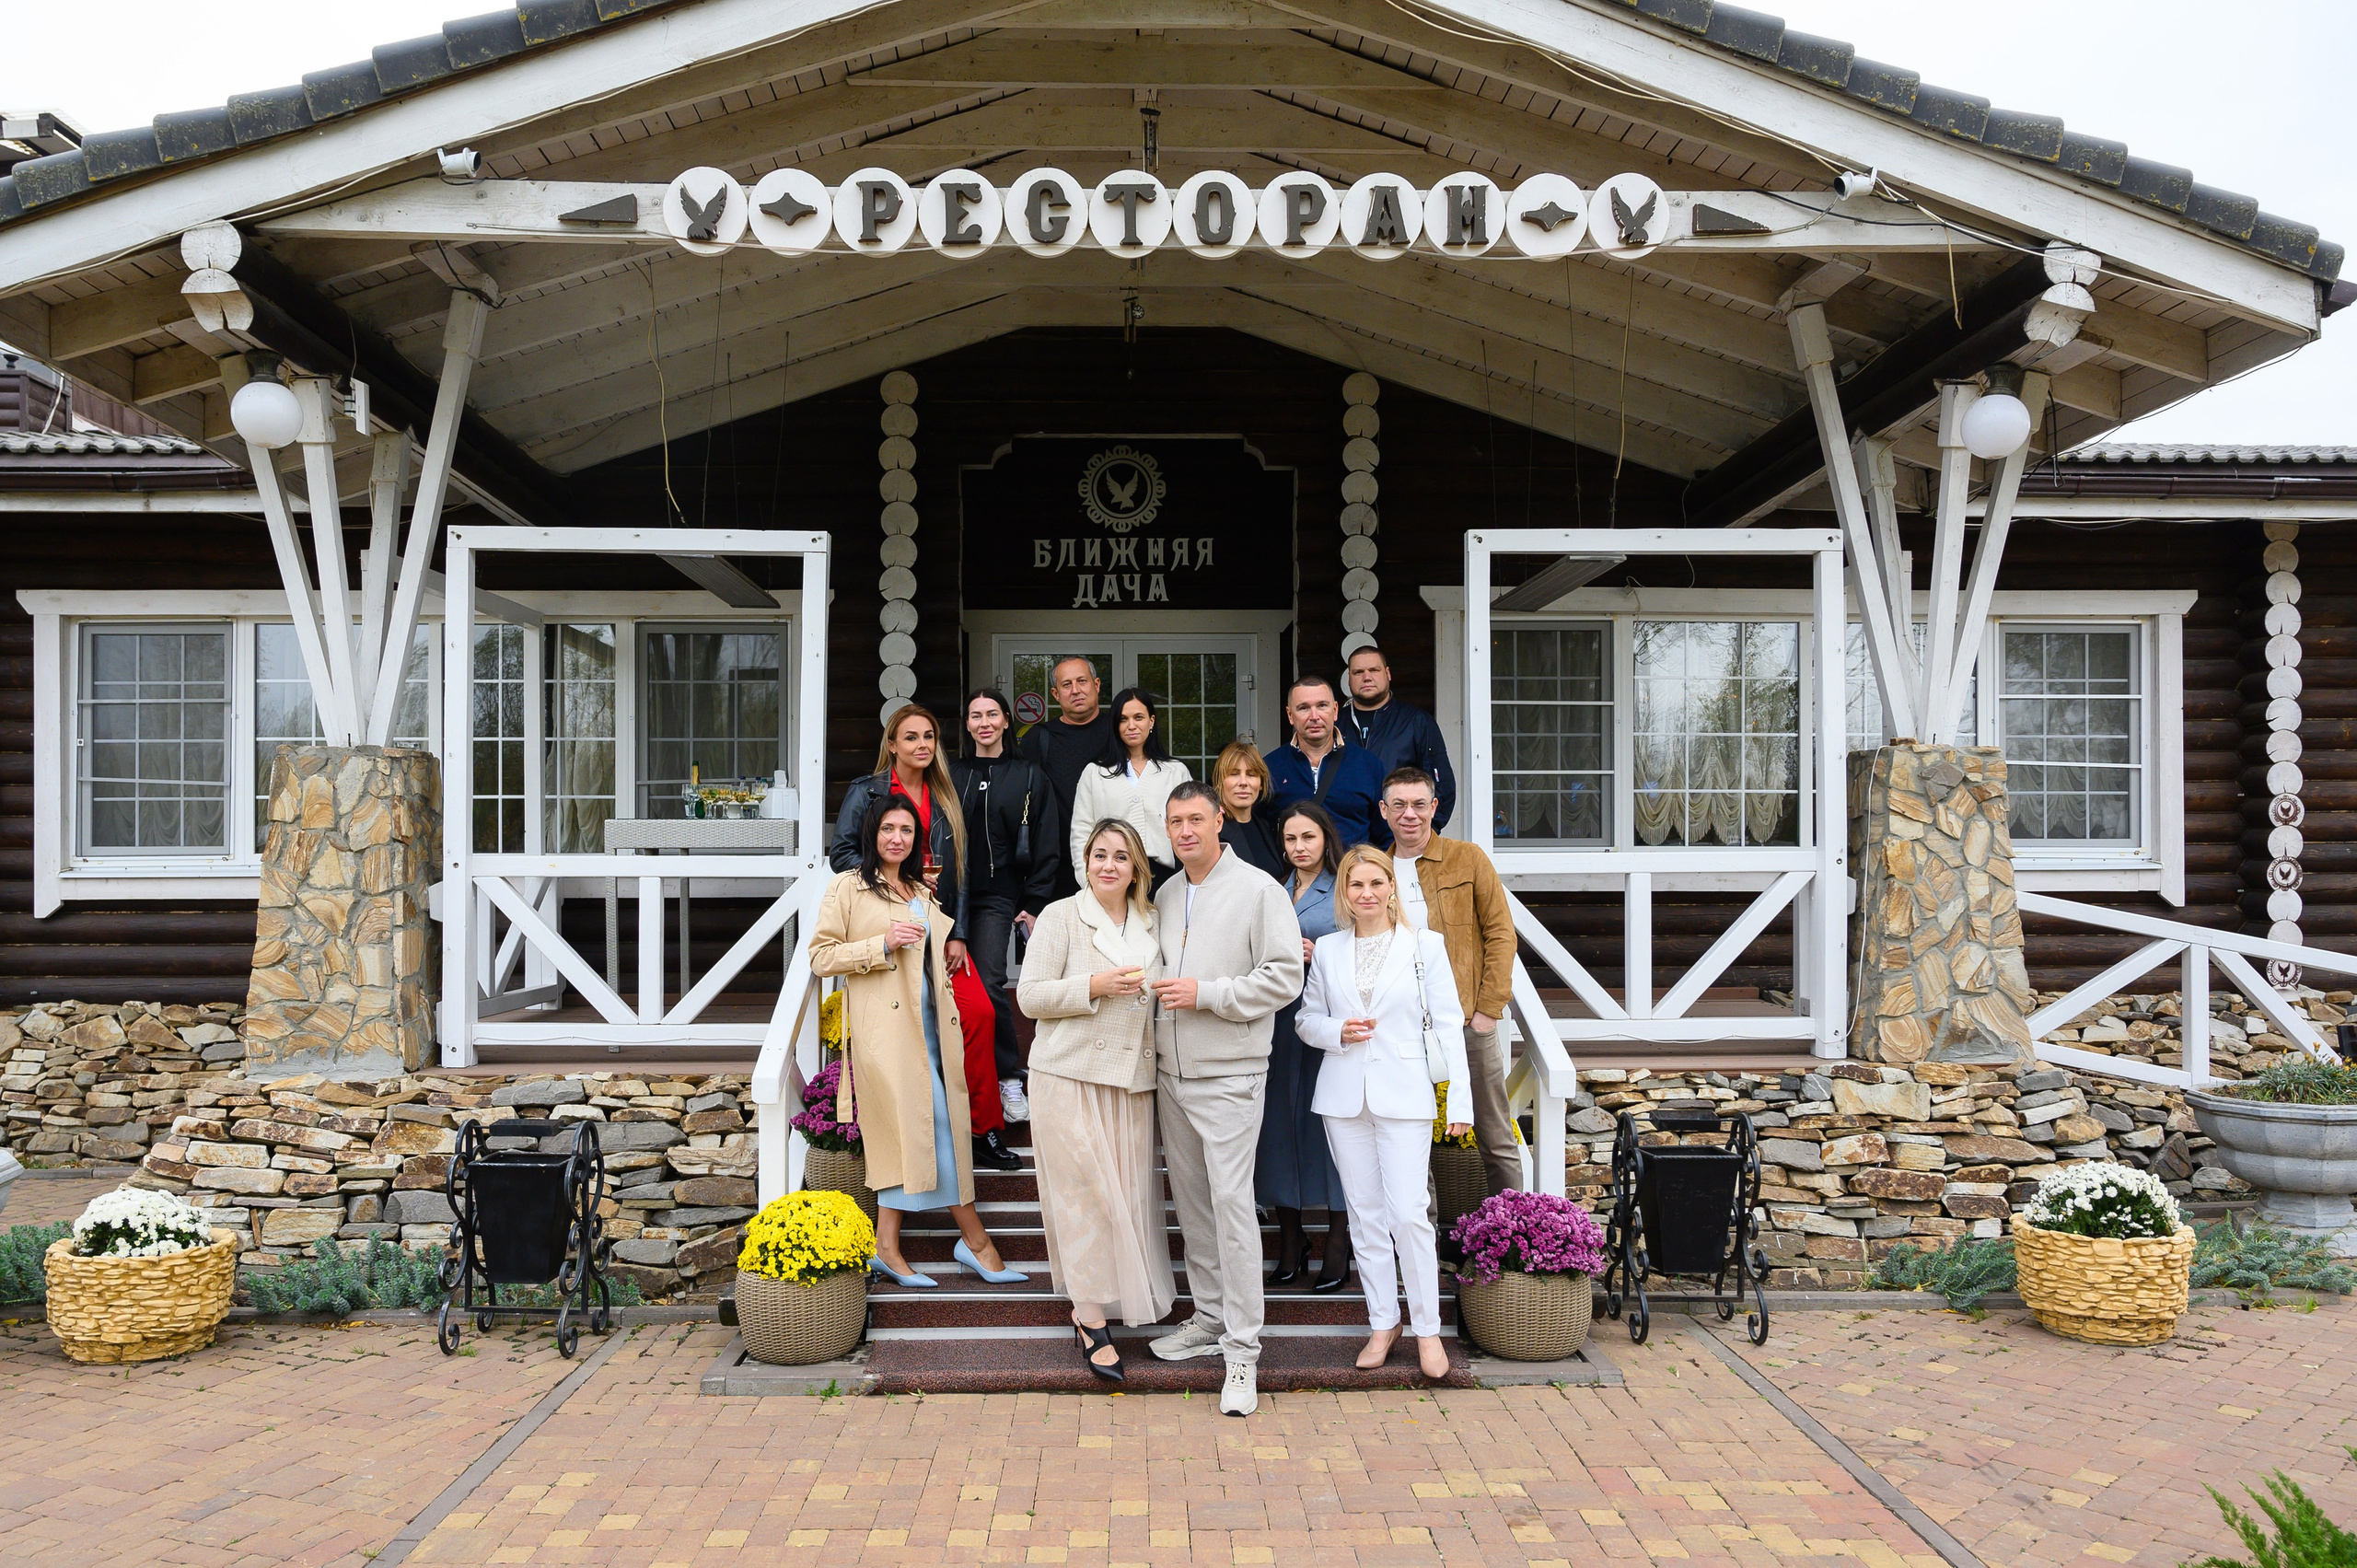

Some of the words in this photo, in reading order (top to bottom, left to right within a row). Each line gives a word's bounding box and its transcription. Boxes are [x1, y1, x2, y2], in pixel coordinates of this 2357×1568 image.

[854, 180, 1490, 248] РЕСТОРАН
[1033, 538, 1214, 573] БЛИЖНЯЯ
[1072, 574, 1170, 609] ДАЧА
